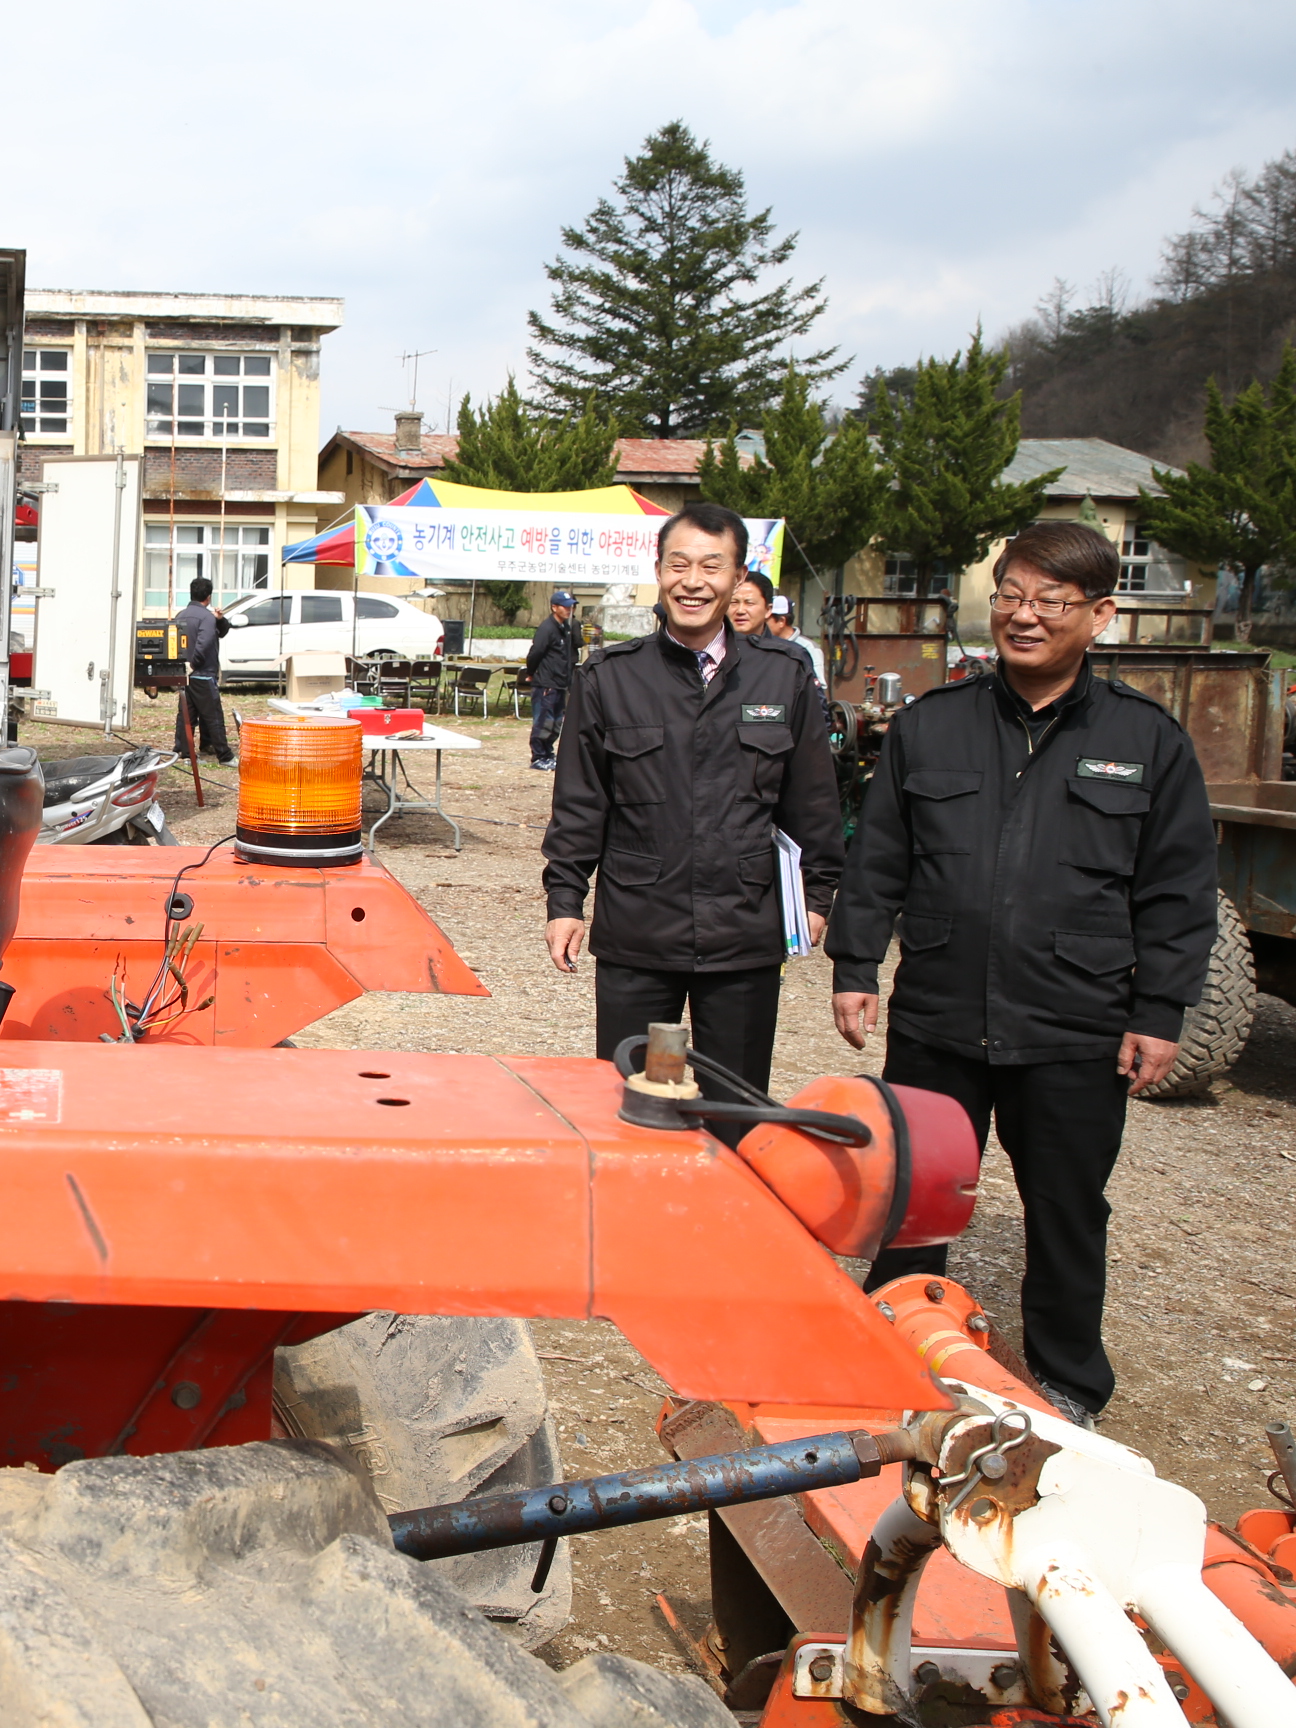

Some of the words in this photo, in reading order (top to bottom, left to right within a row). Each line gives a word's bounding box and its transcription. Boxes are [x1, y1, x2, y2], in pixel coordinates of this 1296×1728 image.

[413, 523, 455, 551] 농기계
[461, 524, 515, 552] 안전사고
[521, 526, 562, 556] 예방을
[567, 528, 594, 556] 위한
[497, 560, 587, 575] 무주군농업기술센터
[591, 563, 640, 576] 농업기계팀
